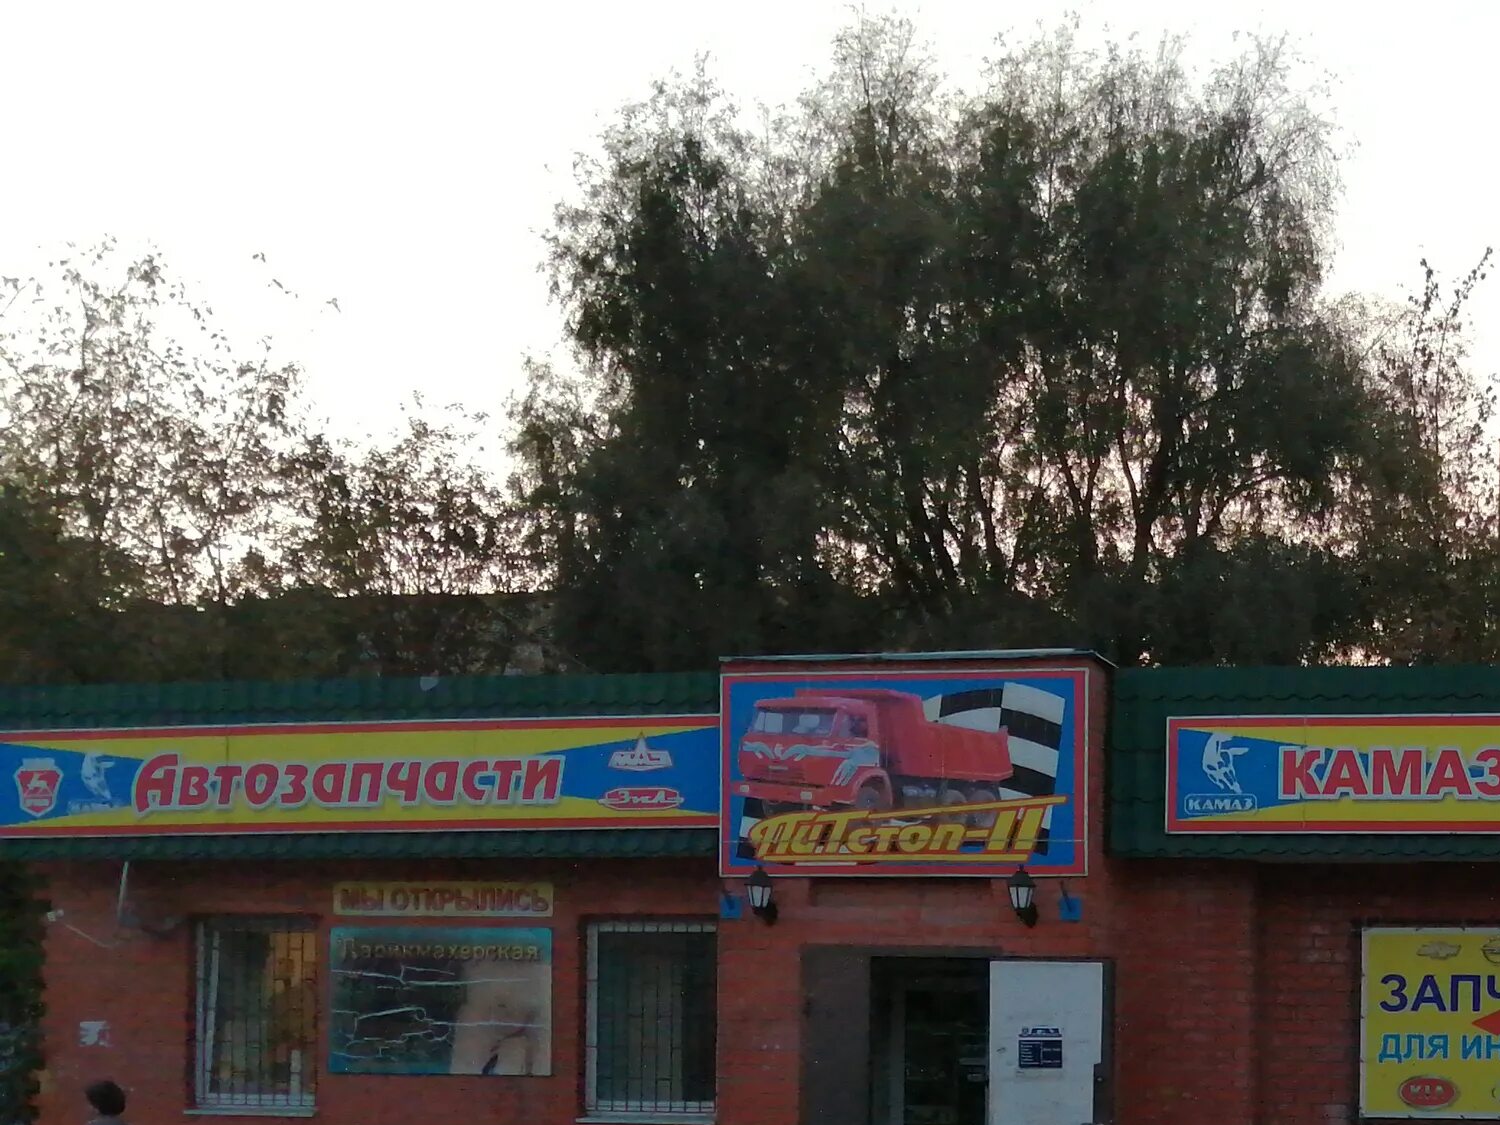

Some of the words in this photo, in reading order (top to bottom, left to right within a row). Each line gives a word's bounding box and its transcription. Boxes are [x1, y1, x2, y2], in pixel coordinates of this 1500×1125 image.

[134, 752, 563, 814] Автозапчасти
[390, 887, 549, 911] ОТКРЫЛИСЬ
[1378, 1034, 1449, 1064] ДЛЯ
